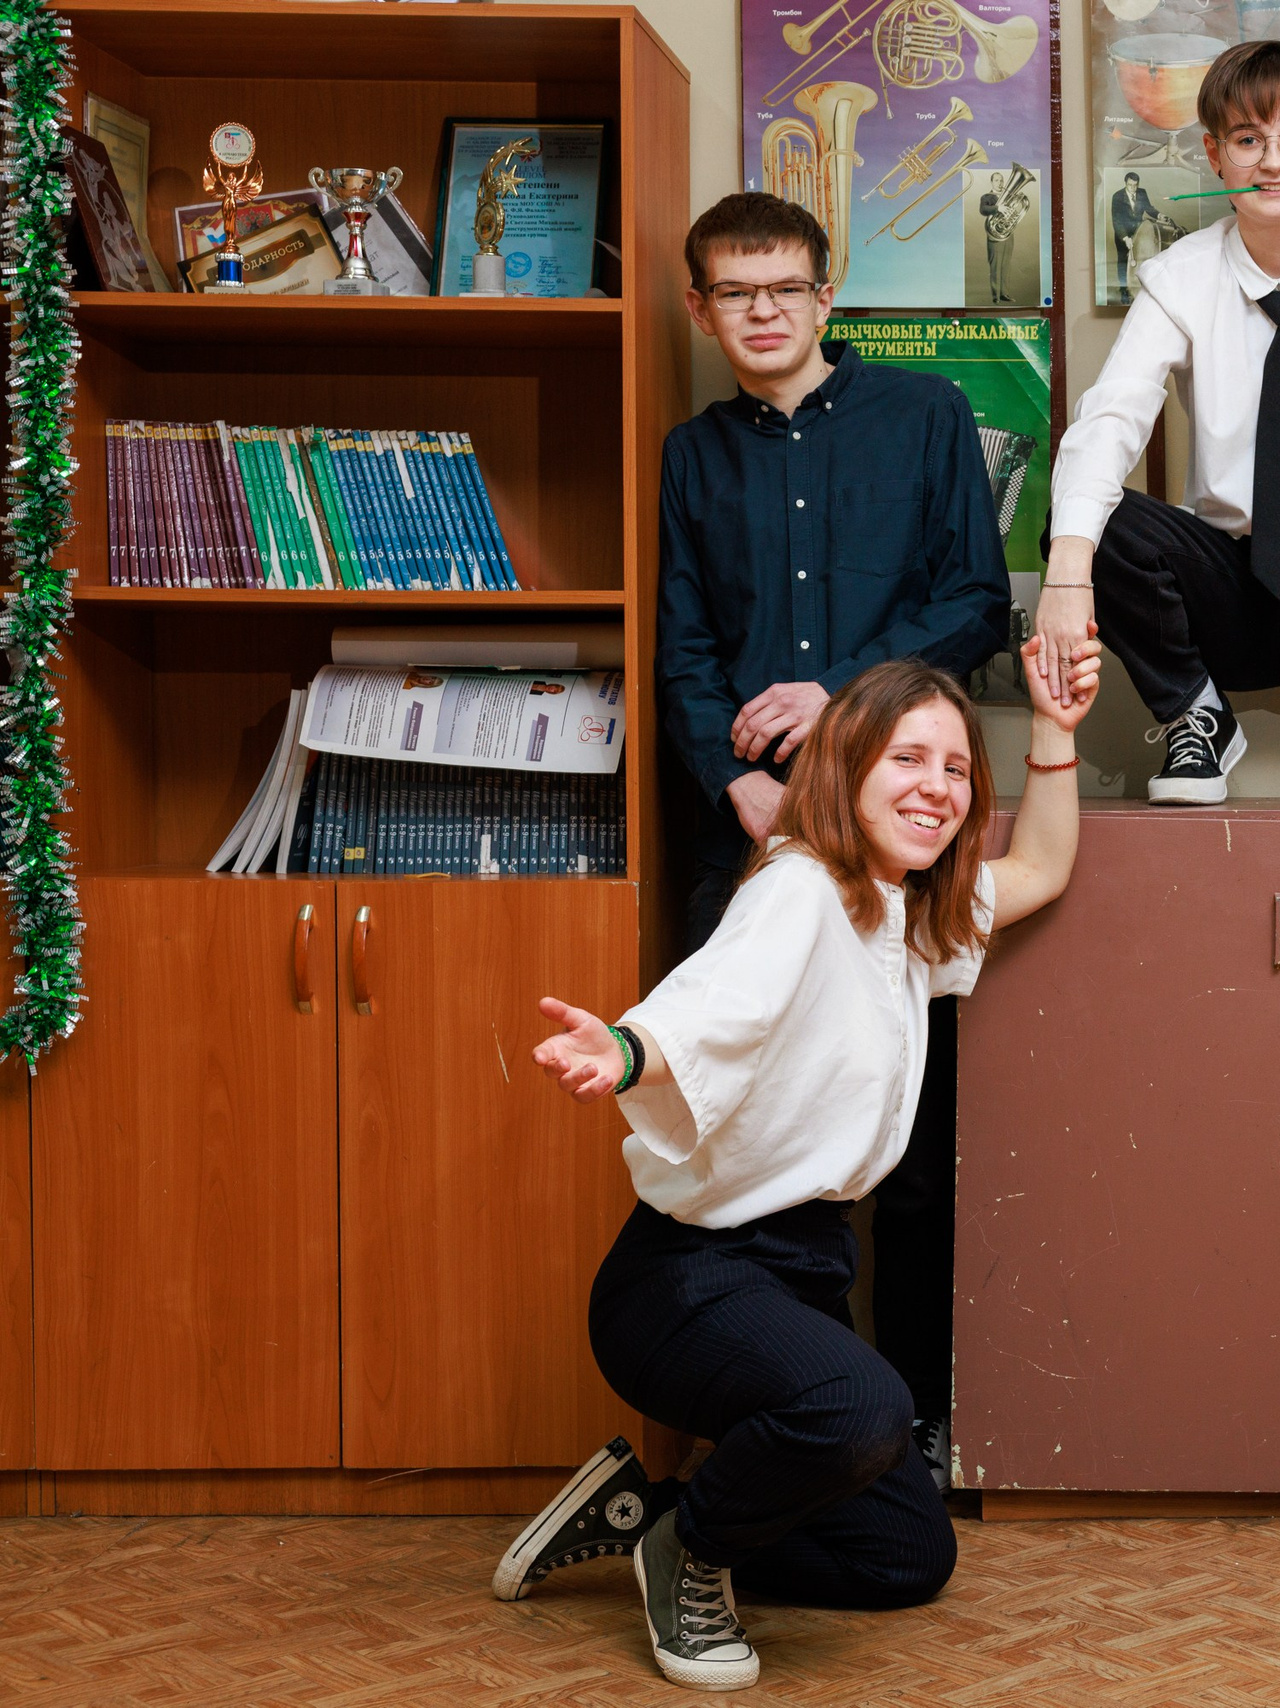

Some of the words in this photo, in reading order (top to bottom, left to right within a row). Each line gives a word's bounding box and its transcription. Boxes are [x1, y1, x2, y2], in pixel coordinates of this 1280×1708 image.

[978, 4, 1011, 13] Валторна
[757, 112, 773, 121] Туба
[916, 112, 936, 121] Труба
[1104, 115, 1133, 125] Литавры
[987, 140, 1004, 149] Горн
[831, 324, 922, 340] ЯЗЫЧКОВЫЕ
[926, 324, 1039, 341] МУЗЫКАЛЬНЫЕ
[852, 341, 937, 357] СТРУМЕНТЫ
[111, 546, 117, 557] 7
[120, 546, 126, 557] 7
[131, 546, 137, 556] 7
[141, 548, 147, 558] 7
[150, 547, 156, 558] 7
[160, 546, 166, 557] 7
[170, 547, 176, 558] 7
[198, 547, 204, 559] 7
[207, 547, 213, 558] 7
[217, 547, 223, 558] 7
[241, 546, 247, 557] 7
[251, 547, 257, 558] 7
[261, 551, 267, 561] 6
[281, 550, 287, 560] 6
[291, 550, 298, 560] 6
[300, 550, 307, 560] 6
[338, 551, 345, 561] 6
[351, 551, 357, 561] 6
[479, 551, 485, 560] 5
[490, 551, 496, 560] 5
[501, 551, 508, 561] 5
[620, 1503, 640, 1528] CONVERSE
